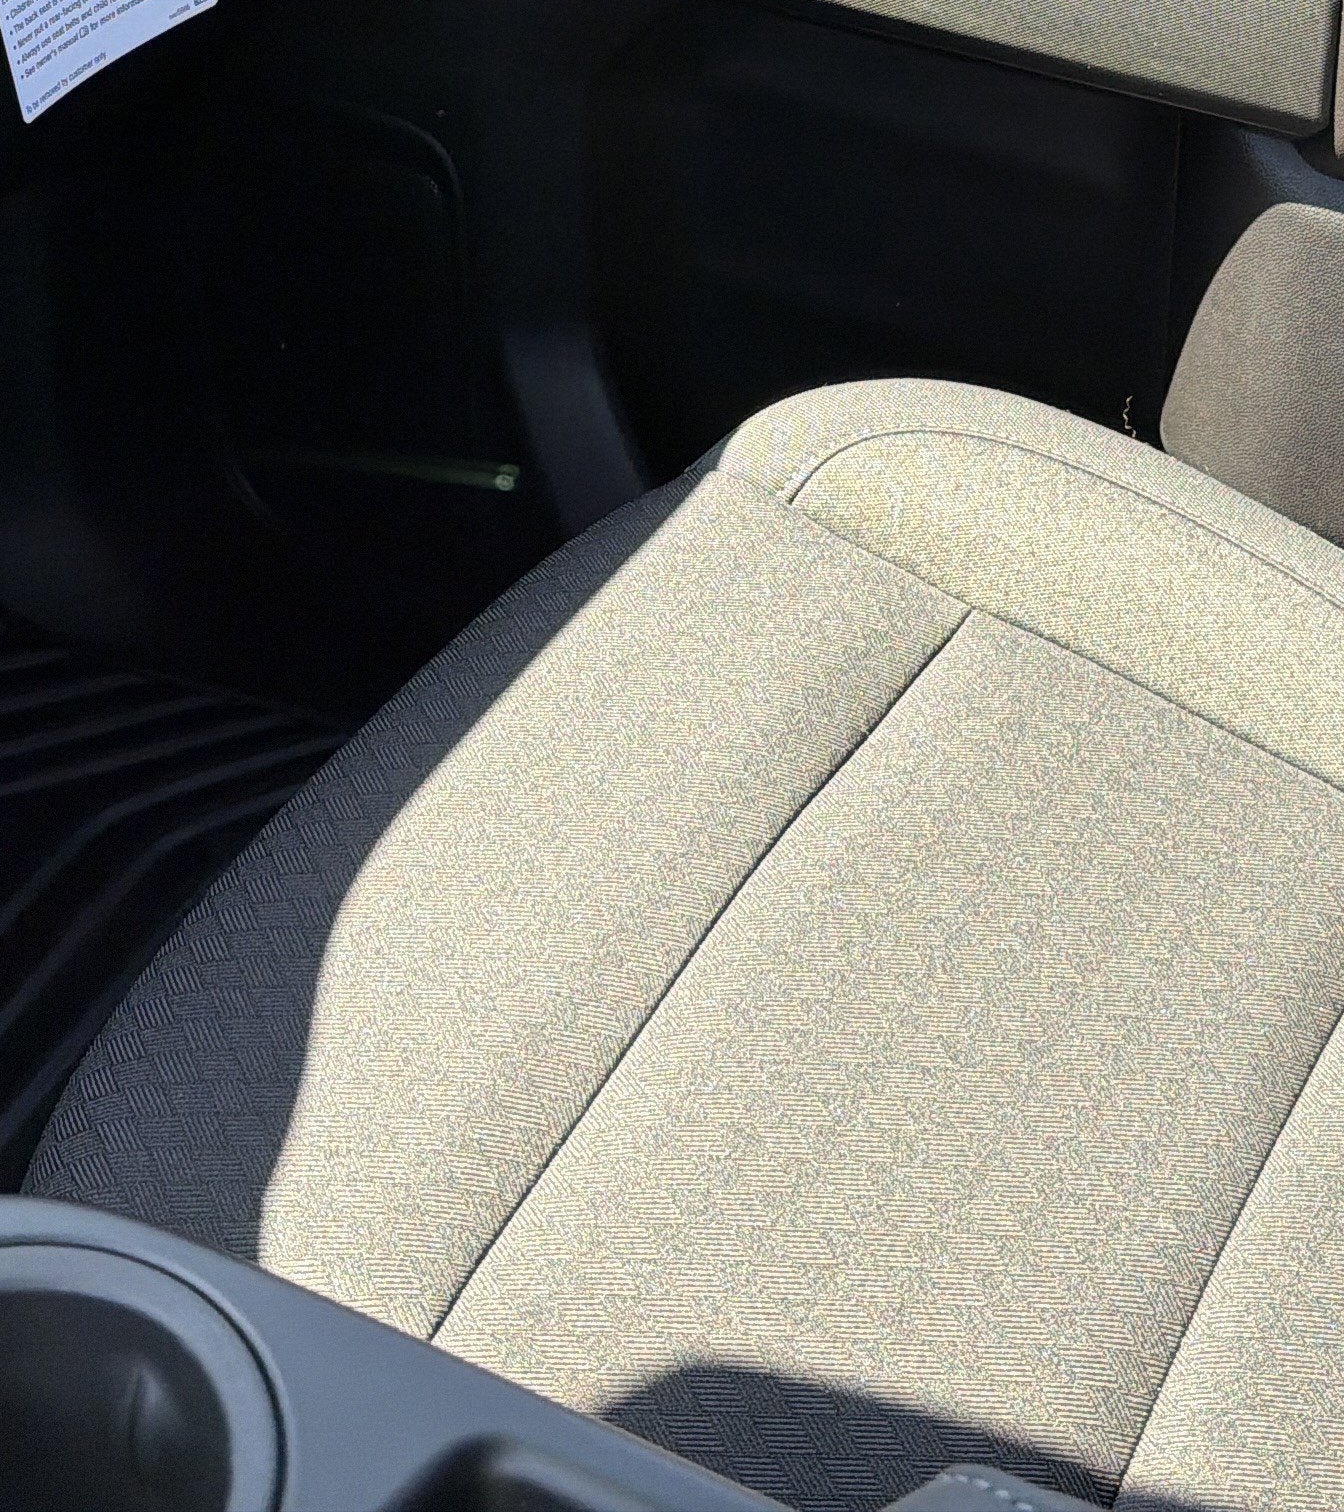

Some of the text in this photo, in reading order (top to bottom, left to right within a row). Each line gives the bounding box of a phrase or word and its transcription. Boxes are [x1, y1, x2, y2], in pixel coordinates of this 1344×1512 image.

[13, 21, 25, 34] The
[24, 10, 39, 26] back
[39, 0, 52, 16] seat
[21, 44, 41, 64] Always
[80, 6, 93, 22] and
[24, 65, 36, 78] See
[89, 21, 99, 31] for
[99, 11, 116, 26] more
[25, 105, 33, 115] To
[32, 100, 40, 110] be
[39, 81, 61, 104] removed
[60, 78, 68, 87] by
[68, 59, 93, 82] customer
